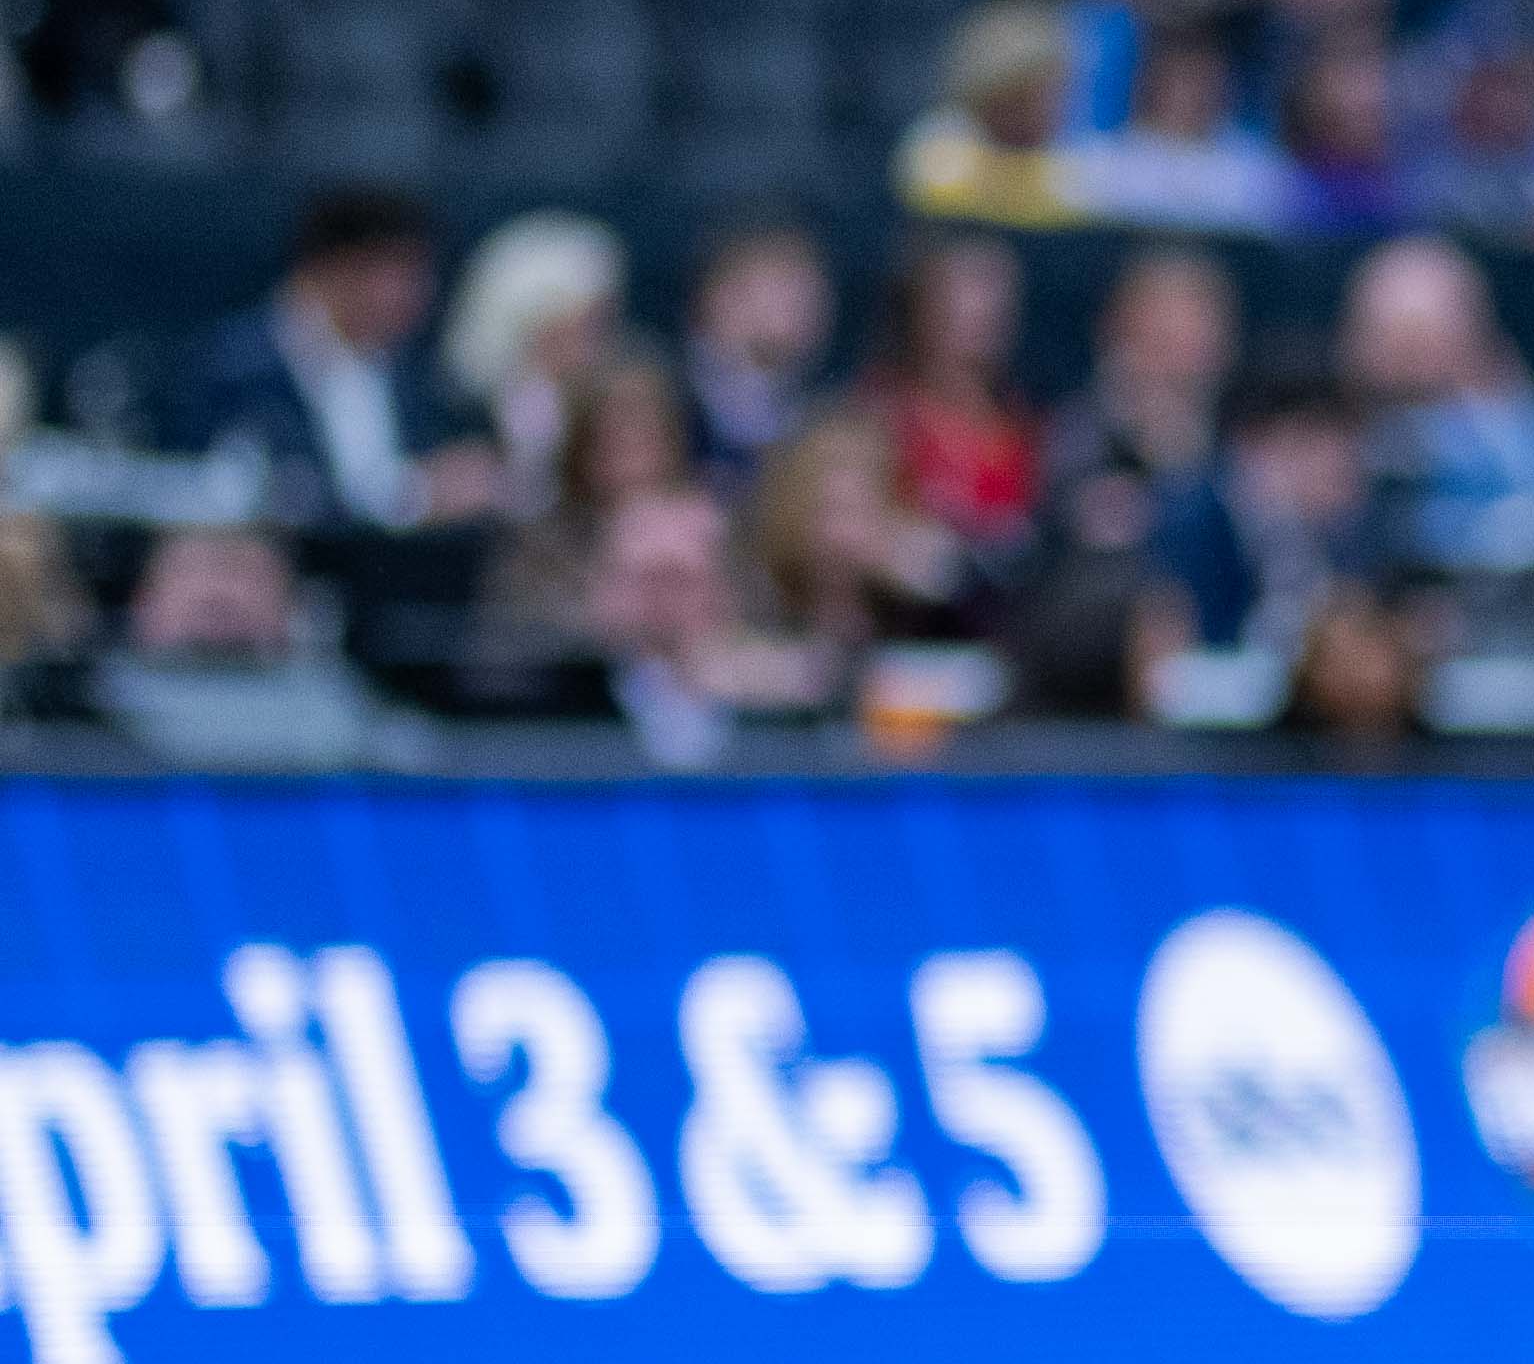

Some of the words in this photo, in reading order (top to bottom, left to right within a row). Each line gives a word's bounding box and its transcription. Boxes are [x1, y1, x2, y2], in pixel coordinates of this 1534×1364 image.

[450, 957, 660, 1300] 3
[680, 953, 934, 1293] &
[910, 949, 1106, 1284] 5
